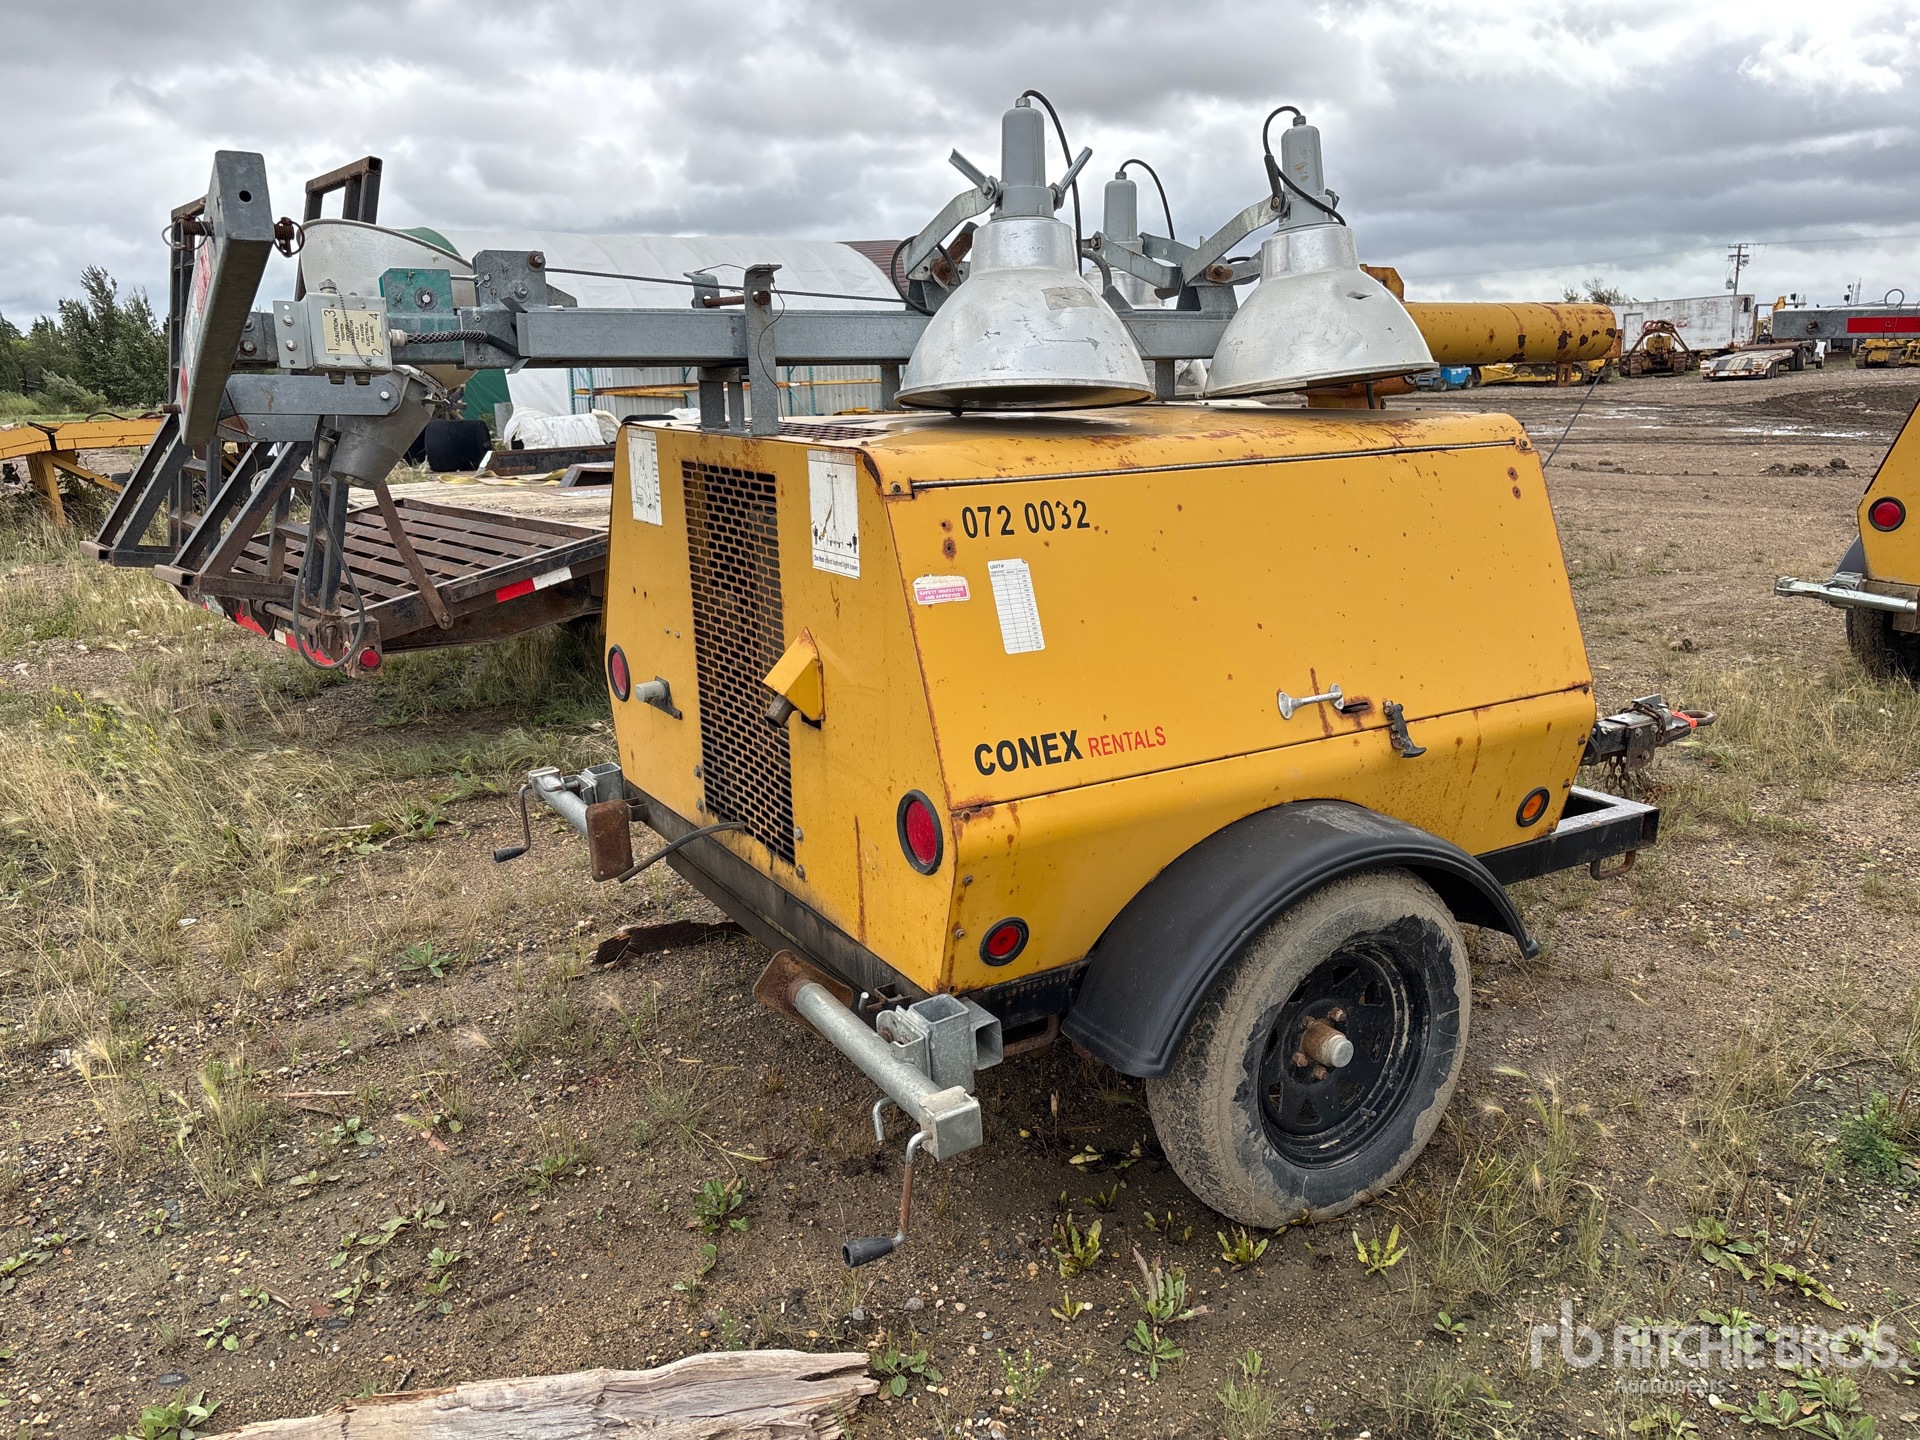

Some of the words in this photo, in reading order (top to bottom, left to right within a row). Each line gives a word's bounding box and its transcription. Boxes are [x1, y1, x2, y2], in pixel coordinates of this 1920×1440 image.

[961, 504, 1015, 539] 072
[1023, 499, 1091, 534] 0032
[974, 729, 1084, 776] CONEX
[1087, 725, 1167, 758] RENTALS
